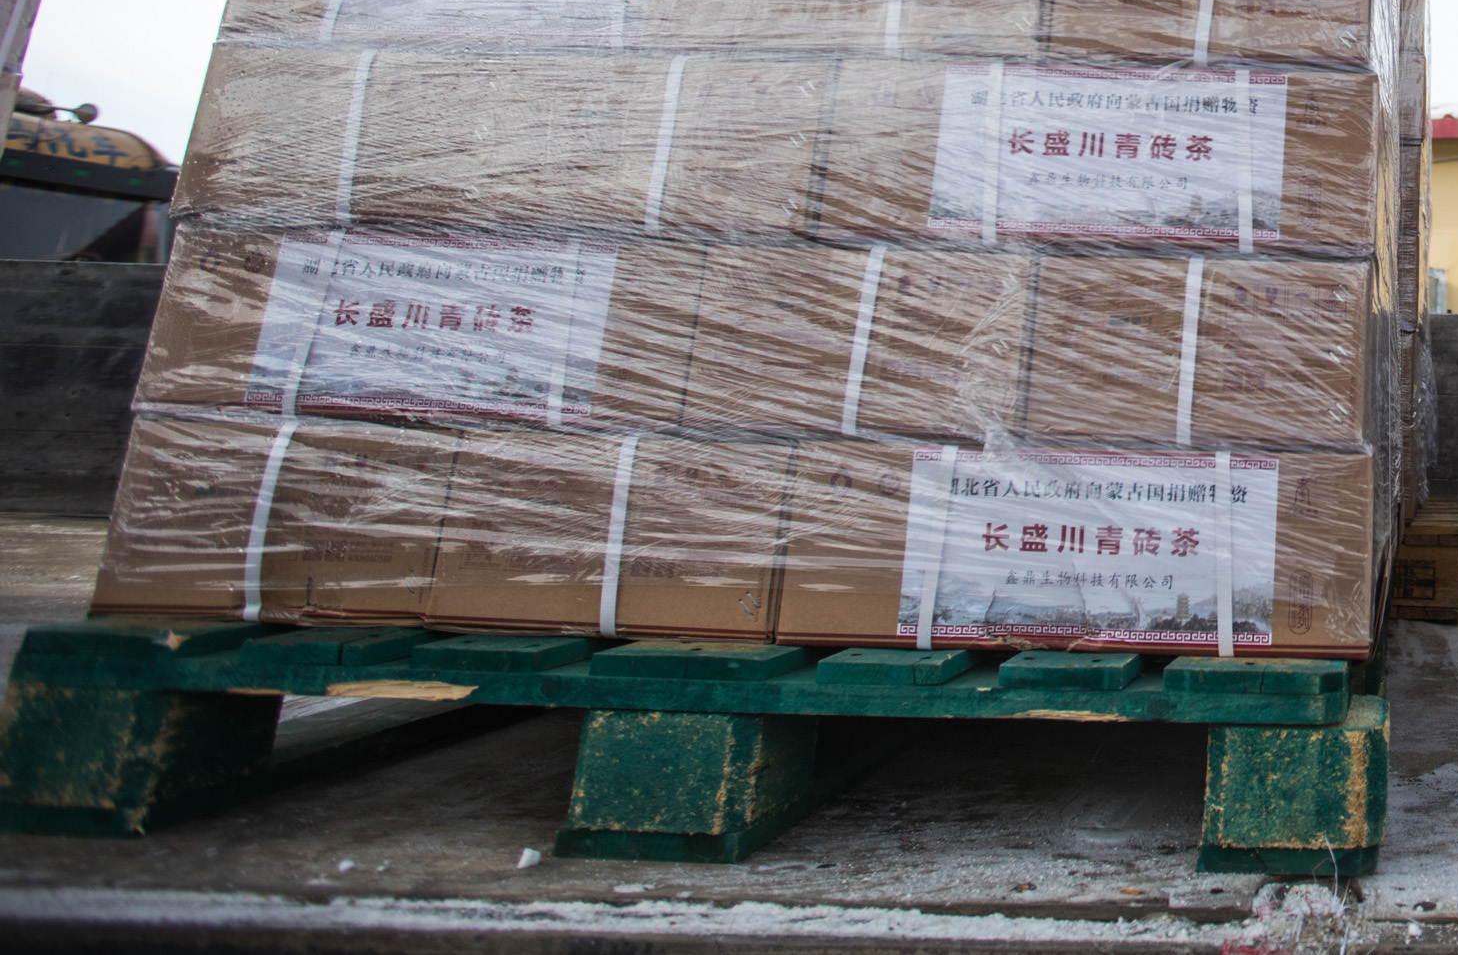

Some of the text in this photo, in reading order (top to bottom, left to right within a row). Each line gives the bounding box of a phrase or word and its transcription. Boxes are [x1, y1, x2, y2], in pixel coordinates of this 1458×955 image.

[1007, 130, 1214, 162] 长盛川青砖茶
[333, 298, 537, 333] 长盛川青砖茶
[981, 522, 1201, 558] 长盛川青砖茶
[1004, 569, 1174, 590] 鑫鼎生物科技有限公司
